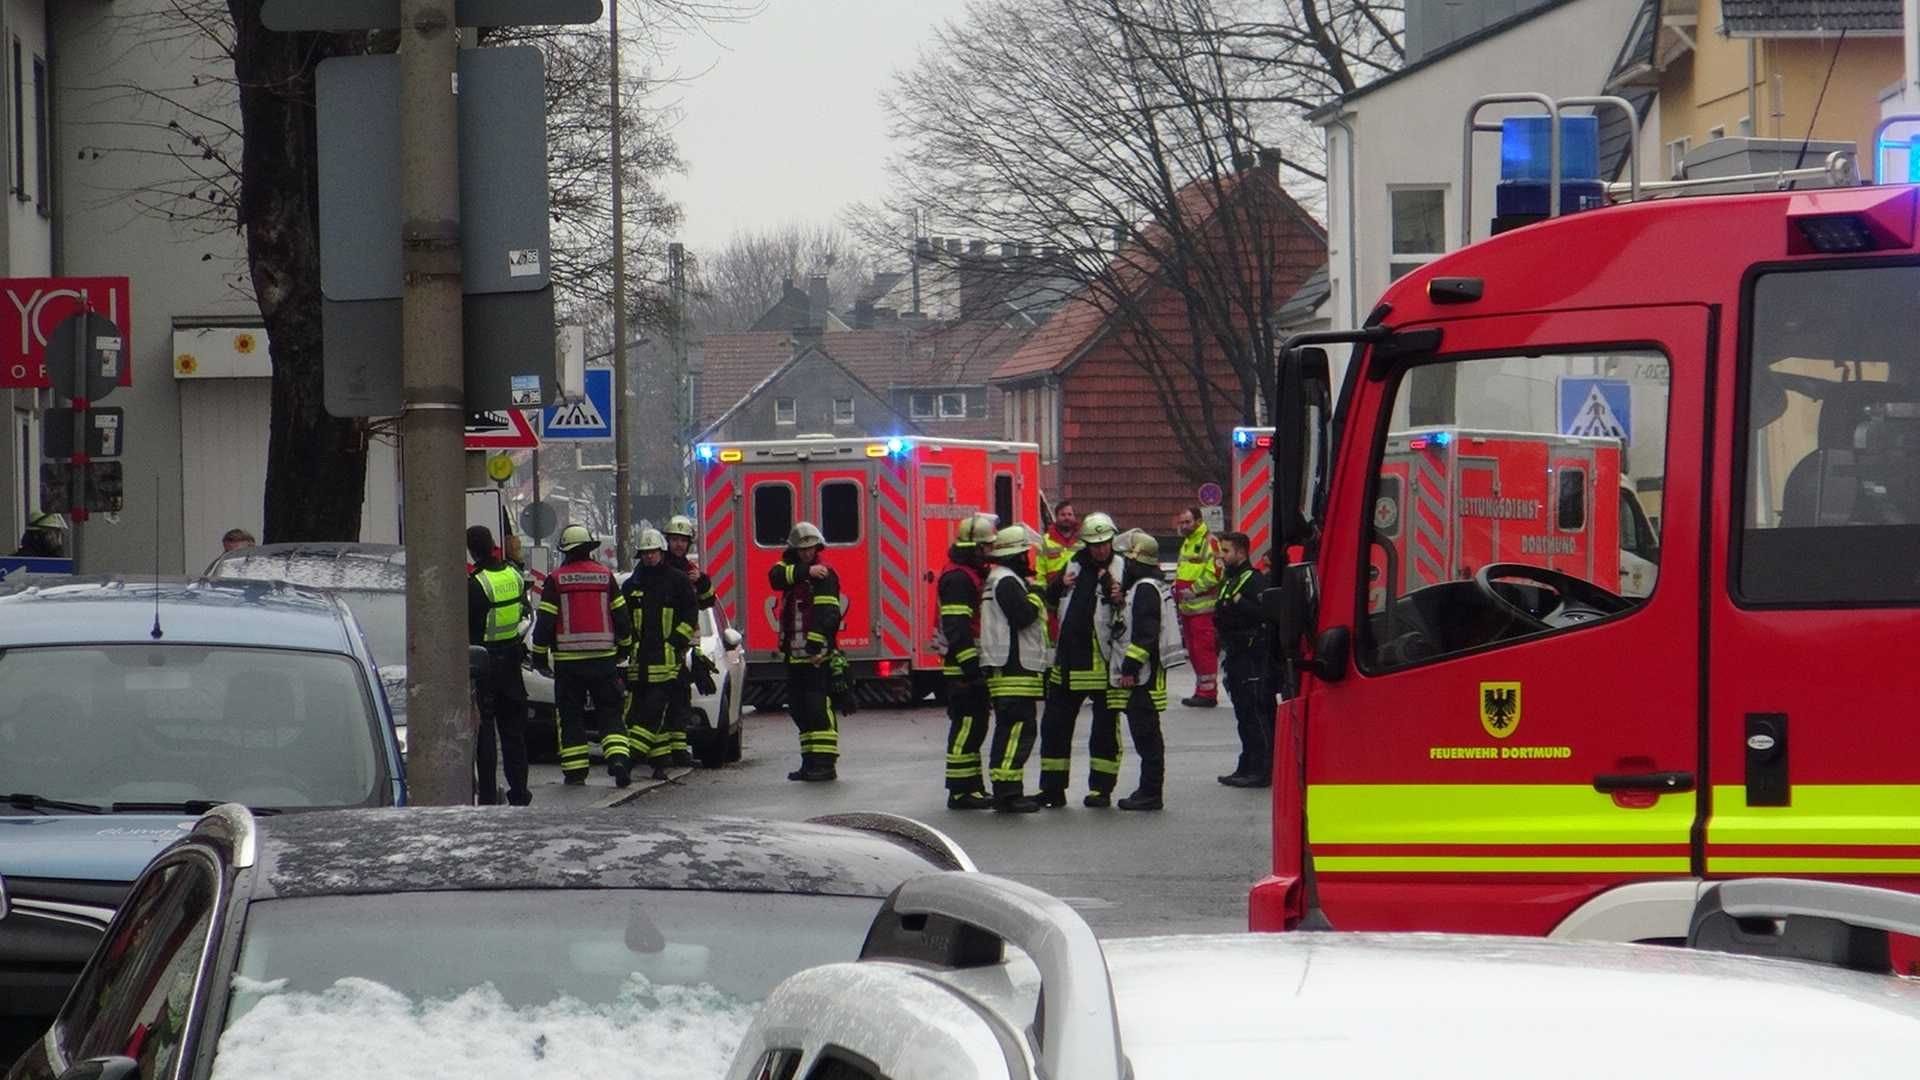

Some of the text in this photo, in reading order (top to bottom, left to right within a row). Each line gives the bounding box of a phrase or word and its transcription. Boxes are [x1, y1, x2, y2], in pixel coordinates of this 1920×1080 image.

[7, 288, 117, 354] YO
[1521, 534, 1576, 554] DORTMUND
[1430, 747, 1571, 760] FEUERWEHR DORTMUND
